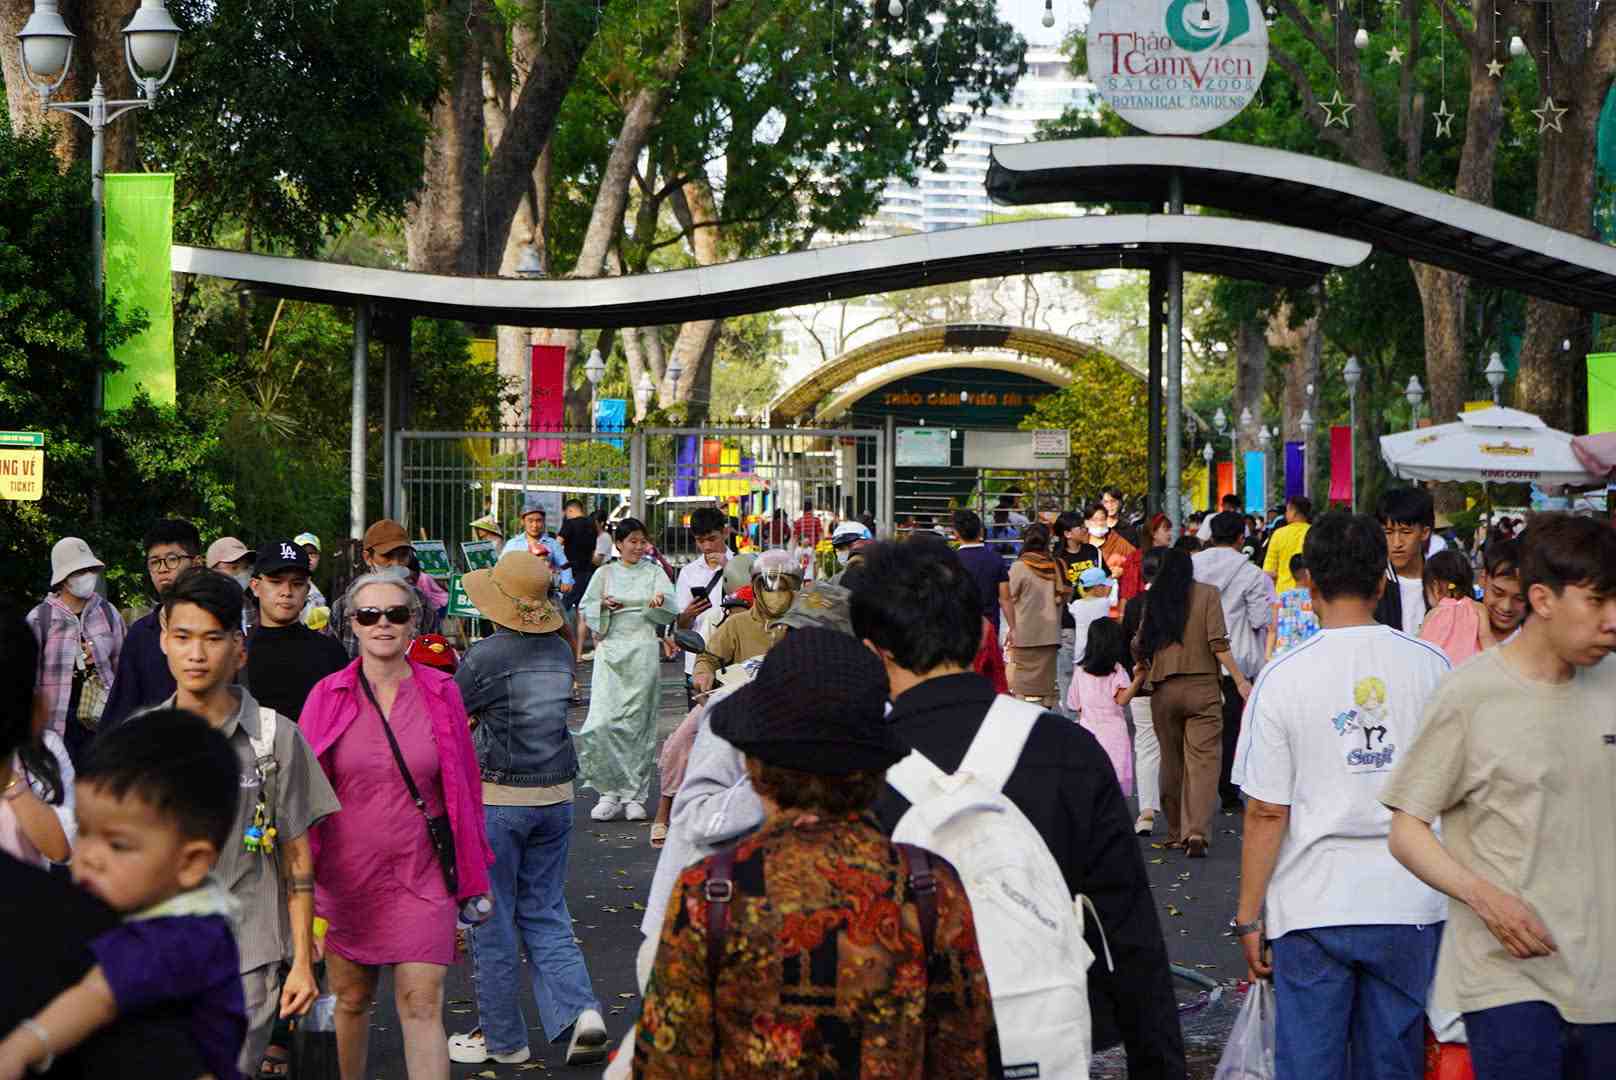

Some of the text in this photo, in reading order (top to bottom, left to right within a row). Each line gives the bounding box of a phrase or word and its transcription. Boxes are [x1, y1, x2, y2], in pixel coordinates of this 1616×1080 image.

[1108, 78, 1194, 90] SAIGON
[1112, 95, 1246, 109] BOTANICAL GARDENS
[1505, 469, 1539, 479] COFFEE
[280, 543, 297, 559] LA
